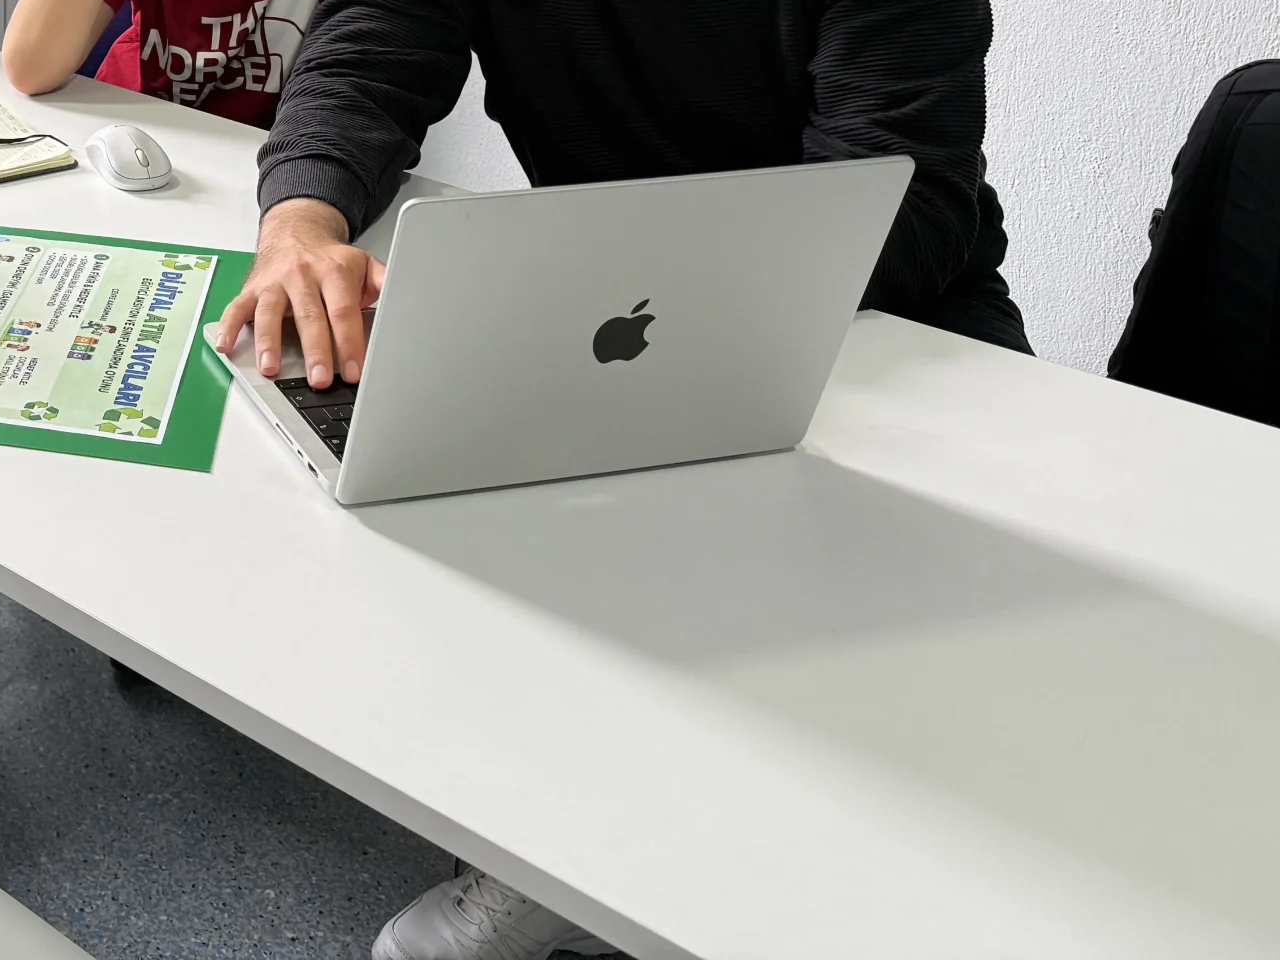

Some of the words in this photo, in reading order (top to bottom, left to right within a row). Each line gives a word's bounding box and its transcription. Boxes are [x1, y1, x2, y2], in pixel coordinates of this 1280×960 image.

[19, 253, 33, 266] OYUN
[92, 261, 103, 270] ANA
[6, 266, 26, 288] DENEYİMİ
[85, 271, 99, 283] FİKİR
[137, 277, 153, 295] EĞİTİCİ
[76, 288, 90, 304] HEDEF
[149, 271, 185, 311] DİJİTAL
[68, 304, 83, 318] KİTLE
[128, 295, 144, 318] AKSİYON
[137, 313, 166, 343] ATIK
[108, 326, 132, 368] SINIFLANDIRMA
[26, 357, 37, 371] HEDEF
[98, 370, 115, 393] OYUNU
[114, 344, 155, 406] AVCILARI
